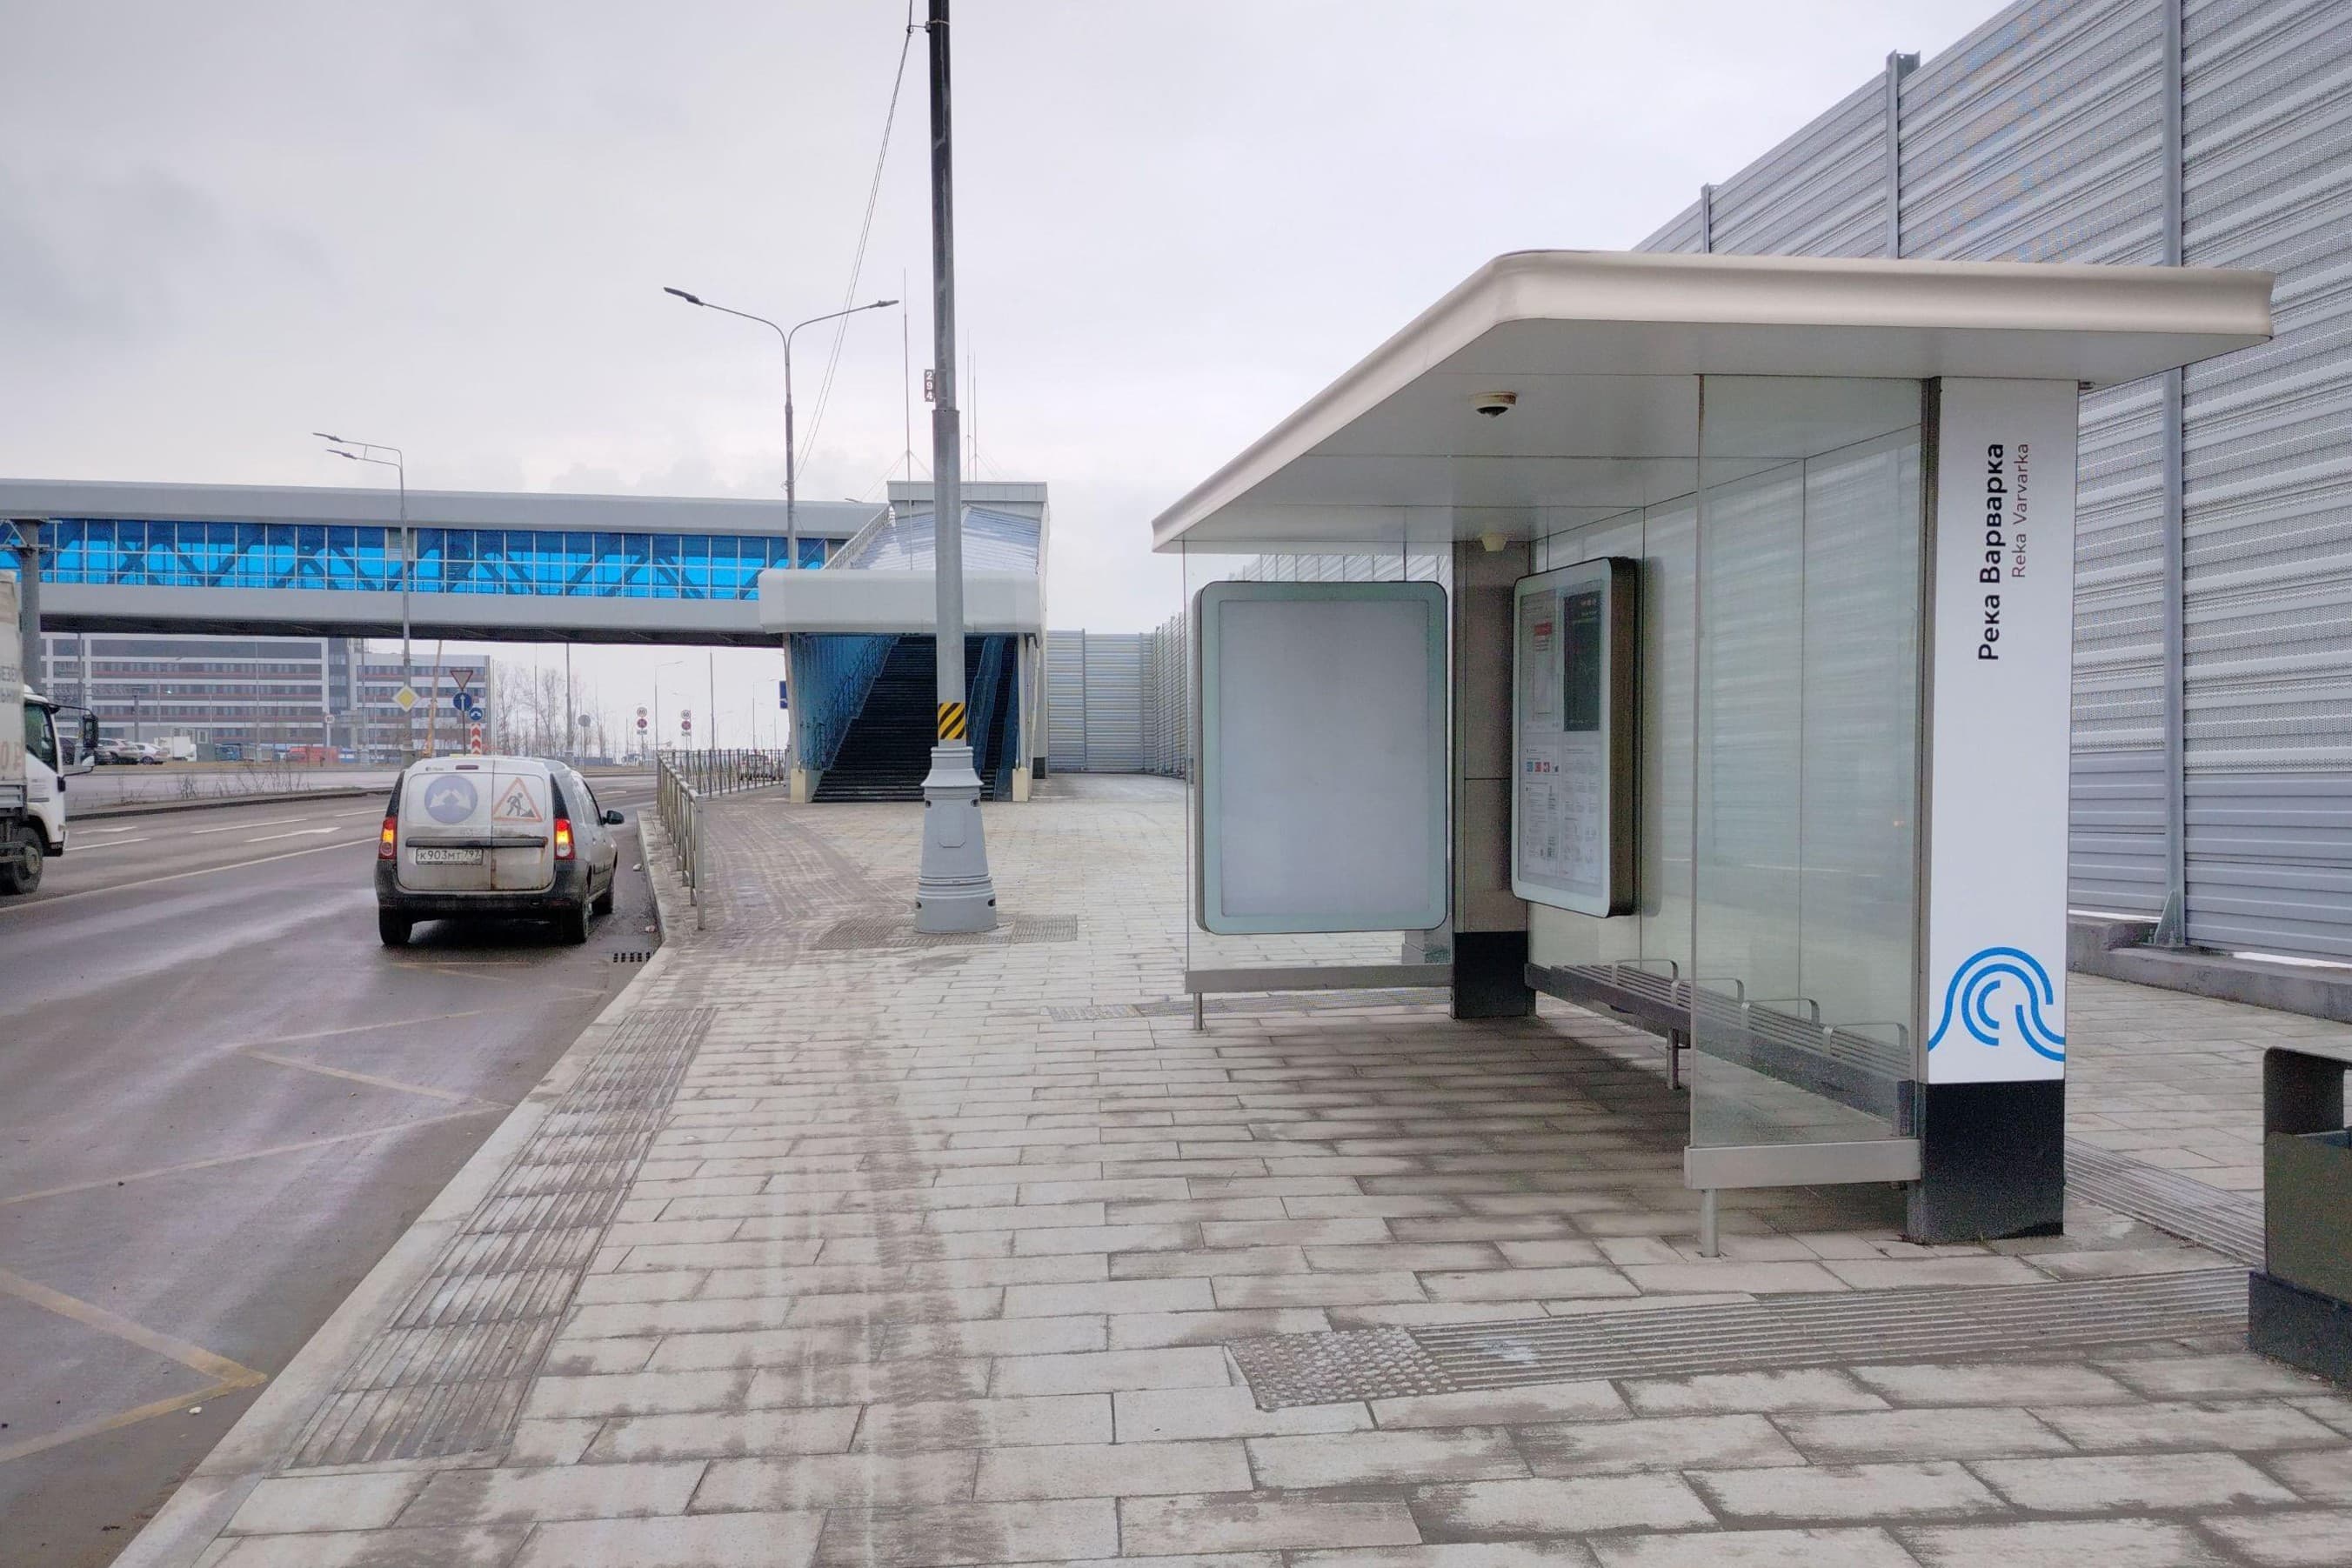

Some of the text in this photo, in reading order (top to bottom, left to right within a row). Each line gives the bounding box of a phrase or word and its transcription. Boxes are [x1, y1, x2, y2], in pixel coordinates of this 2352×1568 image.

[1977, 444, 2008, 661] Река Варварка
[2011, 444, 2028, 578] Reka Varvarka
